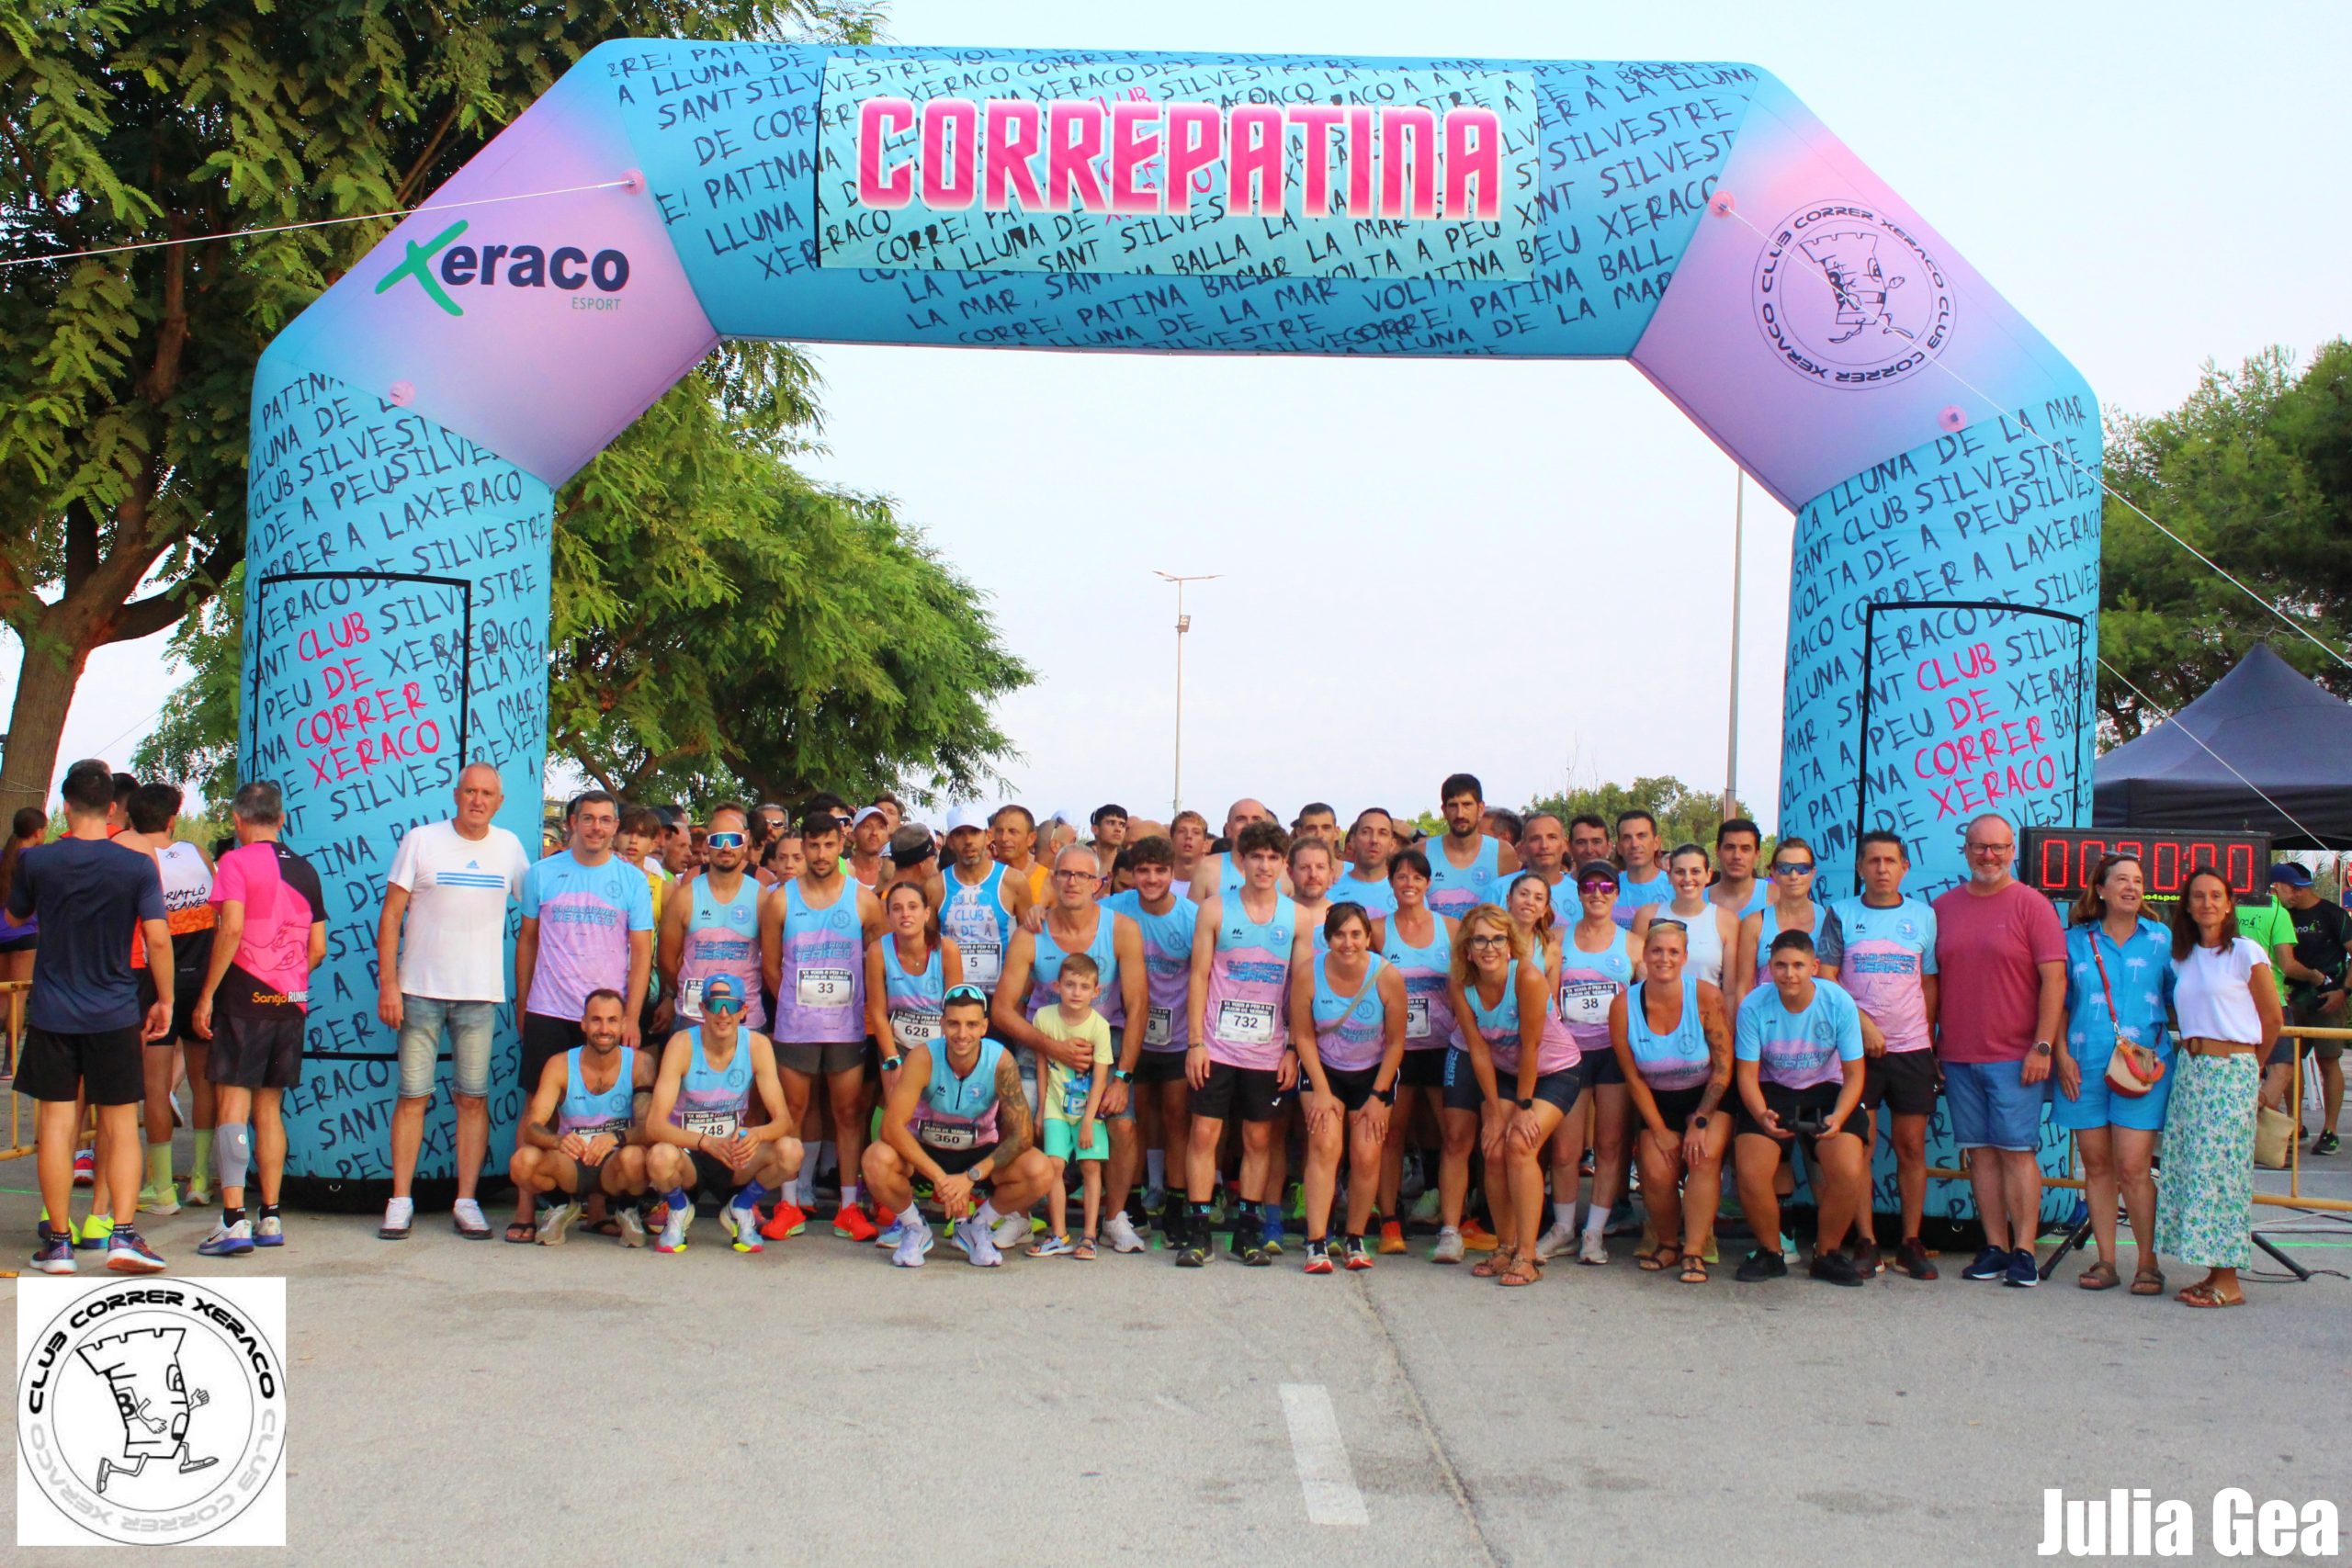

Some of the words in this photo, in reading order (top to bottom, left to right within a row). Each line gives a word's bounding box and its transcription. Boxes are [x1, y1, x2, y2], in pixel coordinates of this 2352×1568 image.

[652, 62, 750, 96] LLUNA
[770, 54, 814, 72] DE
[903, 67, 1009, 103] XERACO
[1028, 67, 1134, 102] XERACO
[1616, 81, 1658, 103] LA
[659, 88, 738, 130] SANT
[1548, 98, 1732, 171] SILVESTRE
[694, 130, 741, 165] DE
[857, 97, 1502, 220] CORREPATINA
[706, 201, 803, 255] LLUNA
[877, 217, 970, 265] CORRE!
[1053, 209, 1095, 242] DE
[960, 223, 1046, 270] LLUNA
[1171, 234, 1250, 276] BALLA
[1306, 232, 1341, 263] LA
[1794, 207, 1873, 230] CORRER
[1881, 219, 1945, 288] XERACO
[375, 220, 629, 317] Xeraco
[1038, 239, 1099, 273] SANT
[1599, 239, 1673, 281] BALL
[571, 297, 622, 311] ESPORT
[902, 275, 944, 304] LA
[1470, 267, 1583, 318] PATINA
[908, 309, 949, 330] LA
[959, 289, 1021, 320] MAR
[1077, 284, 1188, 326] PATINA
[1219, 299, 1260, 324] LA
[1274, 277, 1340, 311] MAR
[959, 314, 1064, 343] CORRE!
[1158, 313, 1204, 336] DE
[1557, 298, 1596, 324] LA
[1493, 313, 1539, 337] DE
[1762, 303, 1828, 379] XERACO
[1928, 296, 1950, 350] CLUB
[1836, 352, 1926, 382] CORRER
[315, 397, 359, 437] DE
[1999, 409, 2037, 443] LA
[2046, 395, 2086, 430] MAR
[254, 468, 294, 519] CLUB
[1803, 507, 1822, 544] LA
[1844, 495, 1908, 545] CLUB
[1915, 436, 2083, 514] SILVESTRE
[1831, 453, 1917, 516] LLUNA
[1936, 426, 1984, 465] DE
[264, 512, 295, 552] DE
[302, 496, 319, 525] A
[331, 465, 395, 511] PEU
[347, 522, 367, 552] A
[379, 502, 424, 540] LA
[413, 470, 521, 522] XERACO
[413, 512, 547, 575] SILVESTRE
[1795, 533, 1832, 592] SANT
[1863, 539, 1910, 581] DE
[1920, 524, 1940, 552] A
[1954, 495, 2018, 539] PEU
[1795, 560, 1857, 623] VOLTA
[1973, 552, 1993, 581] A
[2006, 534, 2044, 571] LA
[2035, 508, 2099, 554] XERACO
[299, 612, 370, 661] CLUB
[265, 678, 311, 727] PEU
[322, 658, 374, 700] DE
[1790, 656, 1849, 720] LLUNA
[1917, 642, 1997, 691] CLUB
[296, 682, 427, 749] CORRER
[307, 719, 440, 790] XERACO
[498, 688, 534, 727] MAR
[1840, 740, 1855, 771] A
[1869, 708, 1934, 756] PEU
[1946, 689, 1999, 730] DE
[1915, 716, 2047, 779] CORRER
[1928, 754, 2054, 822] XERACO
[955, 909, 984, 921] CLUB
[334, 972, 353, 1002] A
[970, 957, 978, 967] 5
[818, 983, 834, 994] 33
[1582, 998, 1599, 1009] 38
[904, 1025, 929, 1037] 628
[1233, 1015, 1259, 1029] 732
[319, 1100, 392, 1150] SANT
[699, 1124, 724, 1136] 748
[934, 1134, 960, 1145] 360
